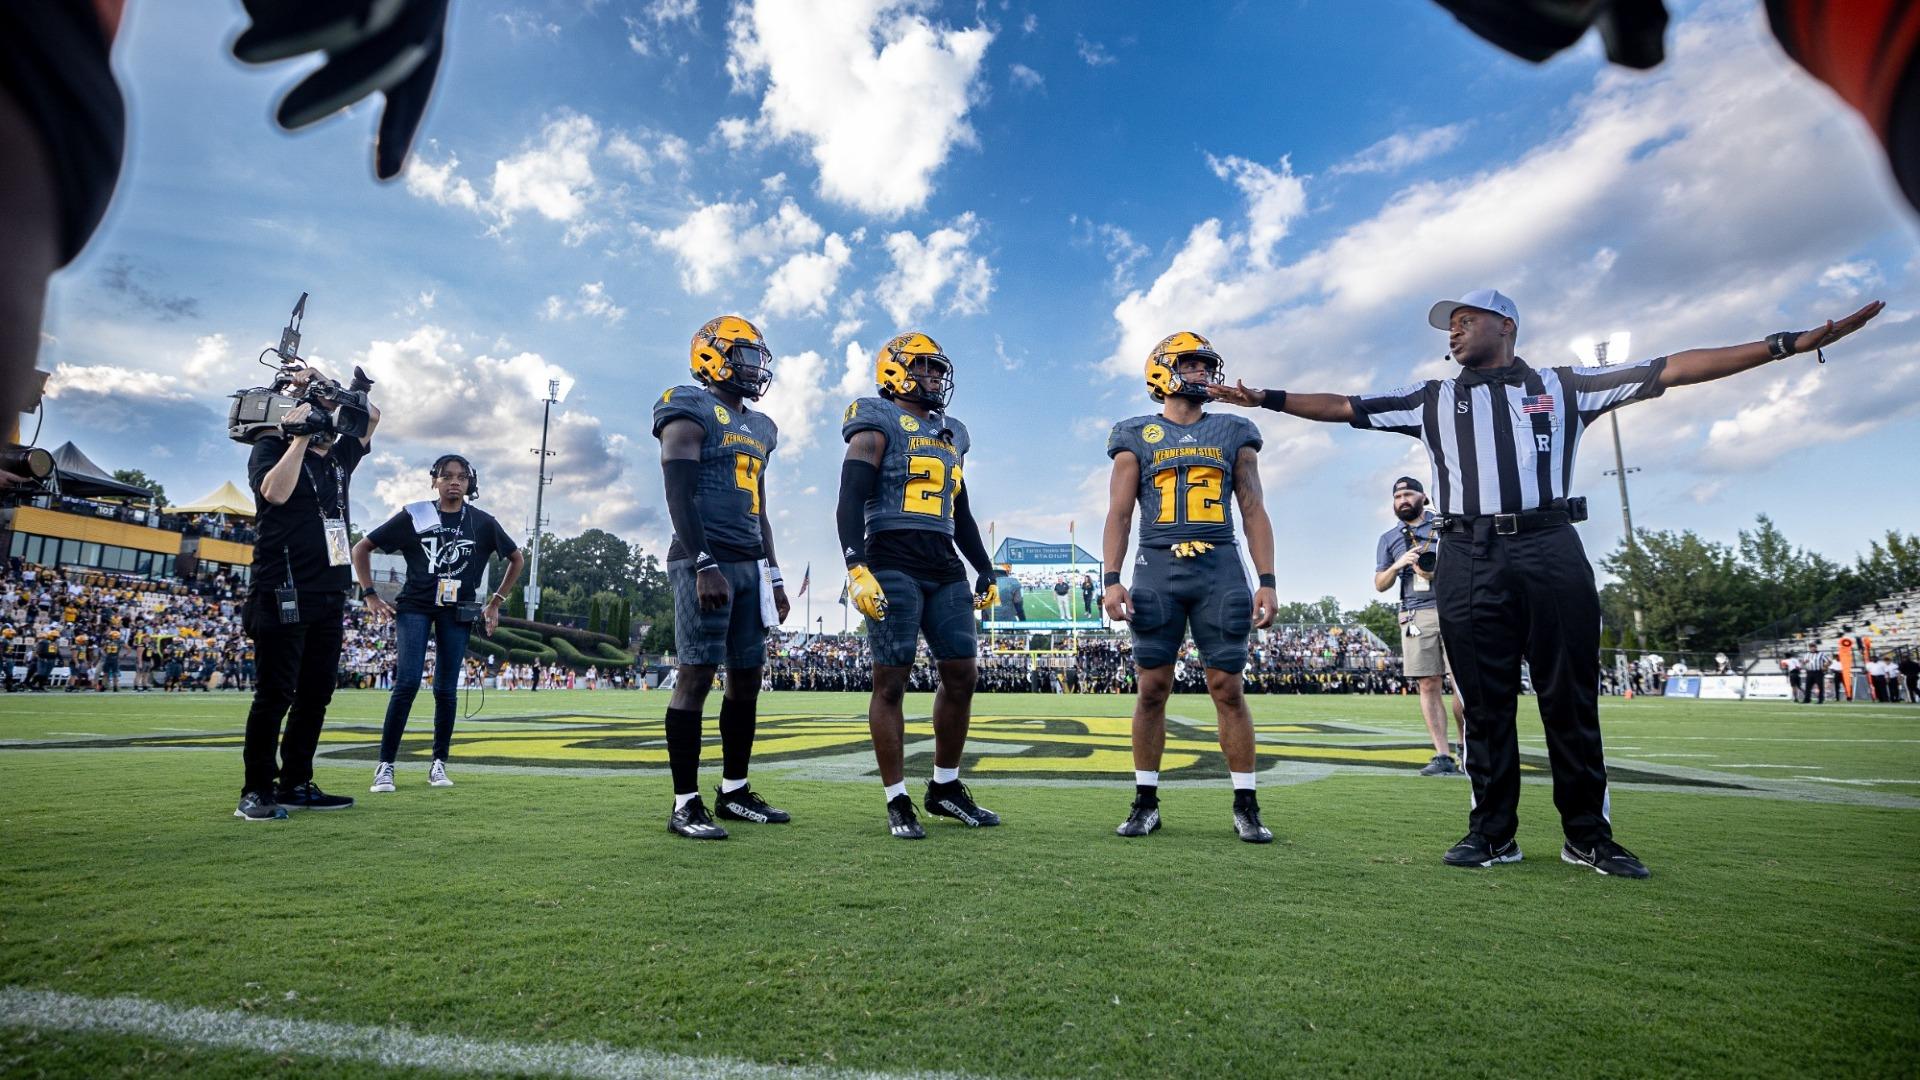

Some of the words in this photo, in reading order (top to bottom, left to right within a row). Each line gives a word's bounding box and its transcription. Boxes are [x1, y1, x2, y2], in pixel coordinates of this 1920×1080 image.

[1457, 401, 1469, 414] S
[1536, 434, 1551, 451] R
[1153, 447, 1198, 465] KENNESAW
[1199, 446, 1224, 463] STATE
[733, 450, 766, 515] 4
[1152, 464, 1228, 525] 12
